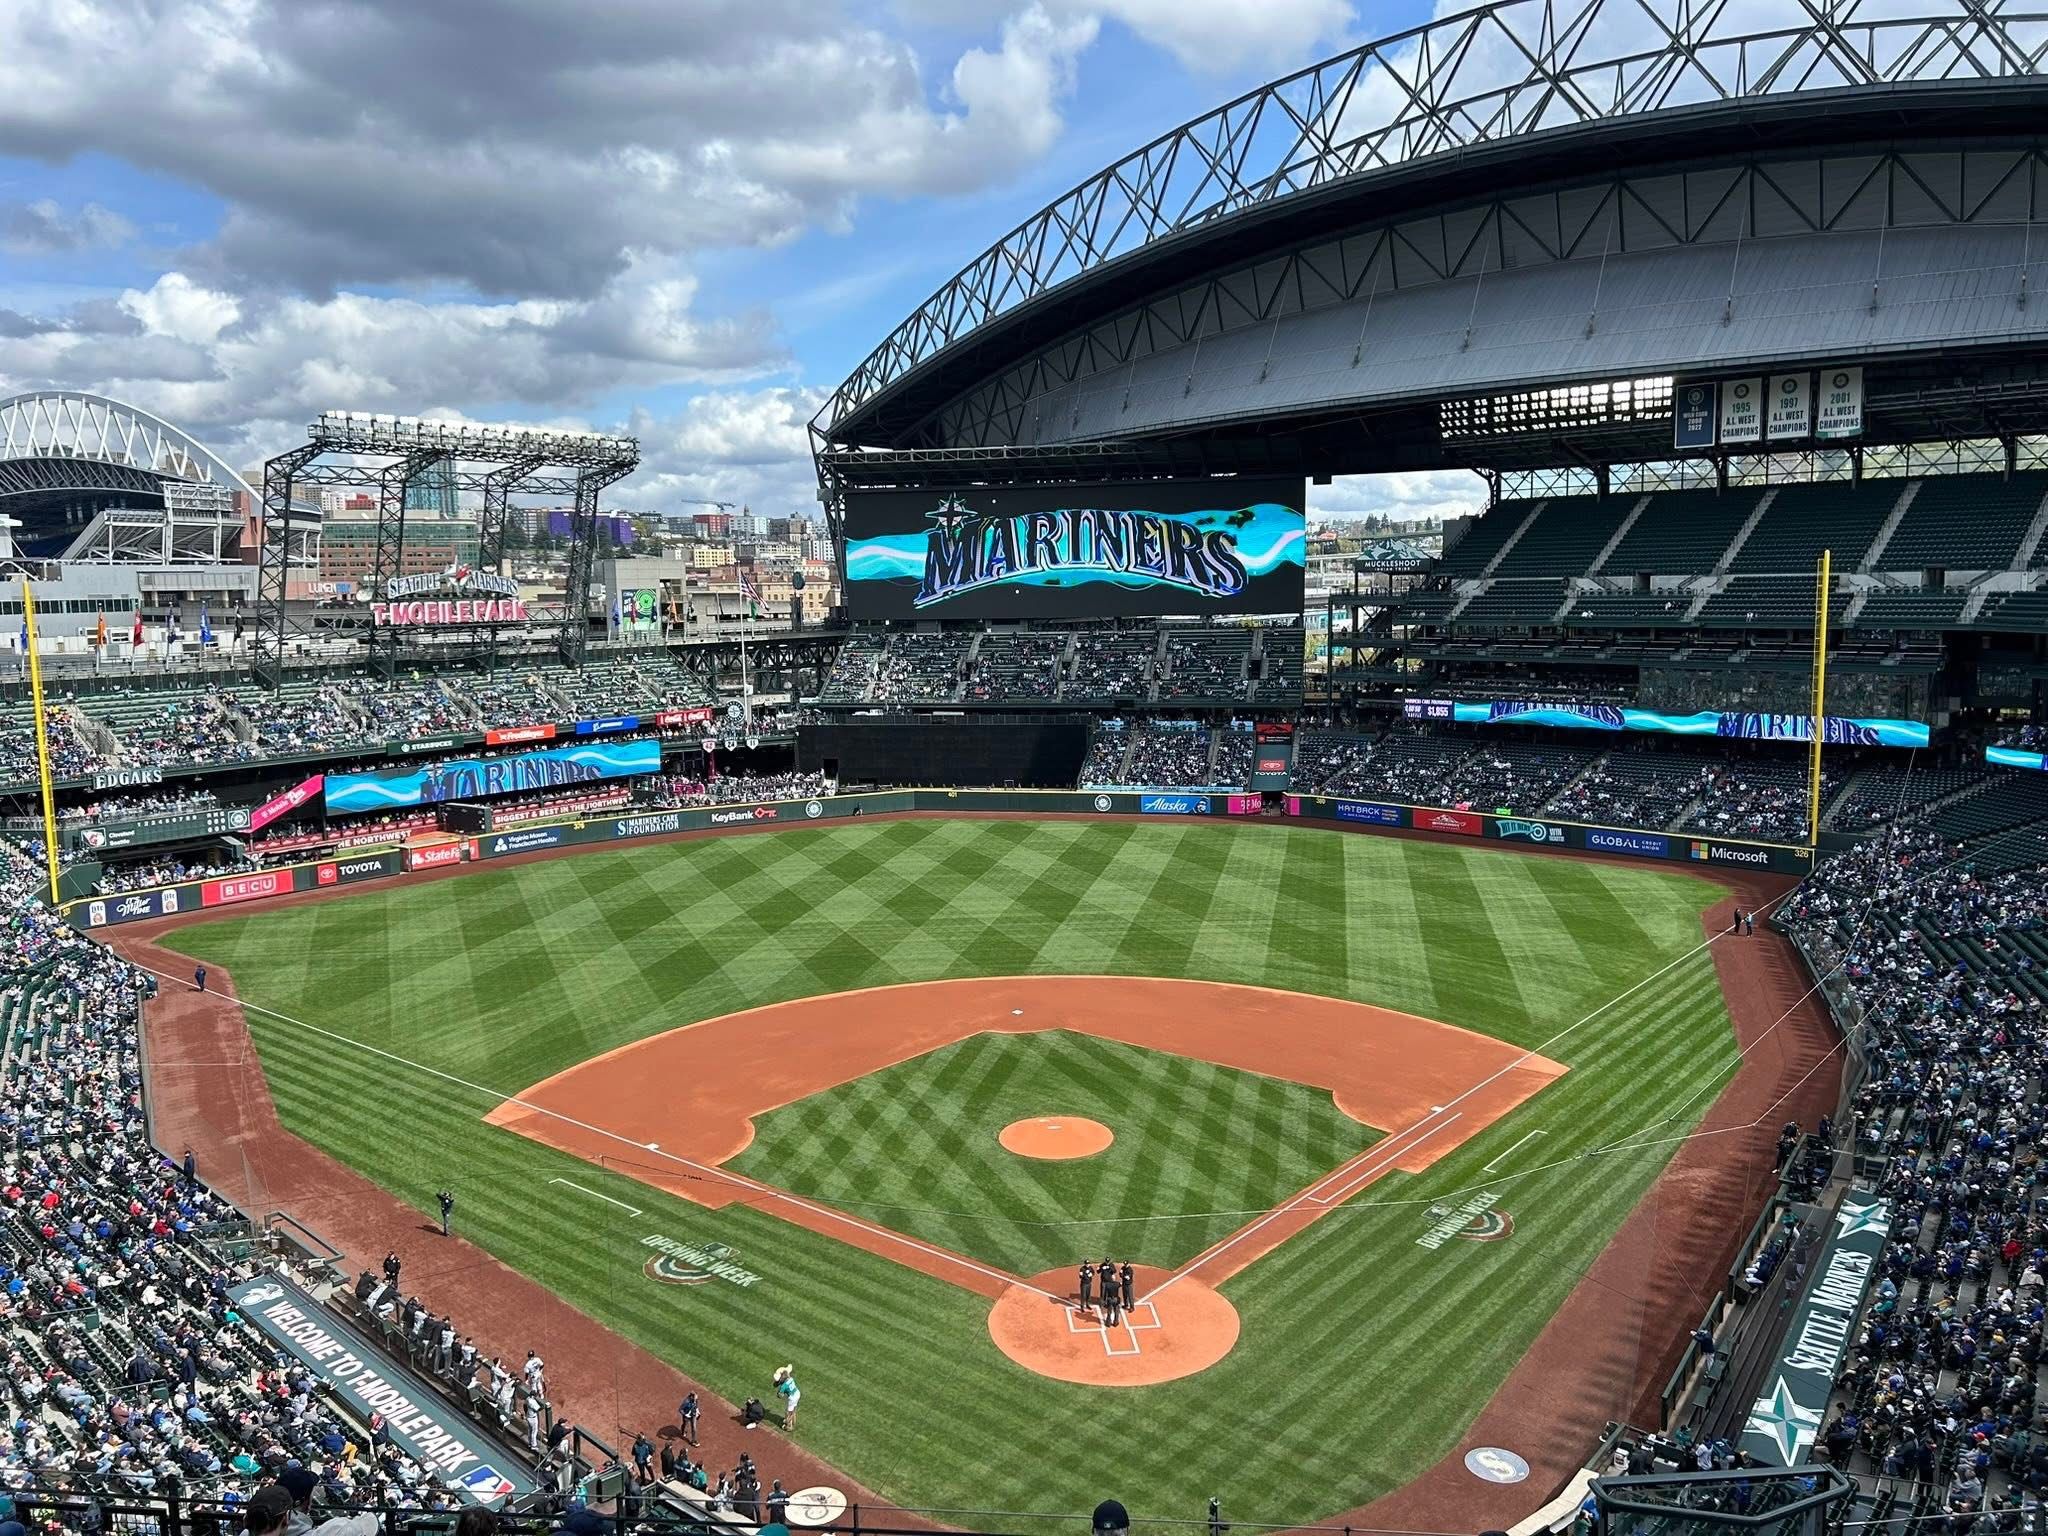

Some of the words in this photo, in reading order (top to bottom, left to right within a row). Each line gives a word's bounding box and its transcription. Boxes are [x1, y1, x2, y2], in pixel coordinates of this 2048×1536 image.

[1780, 397, 1798, 409] 1997
[1830, 392, 1850, 405] 2001
[1732, 402, 1750, 413] 1995
[1837, 405, 1856, 415] WEST
[1738, 414, 1756, 425] WEST
[1785, 410, 1804, 420] WEST
[1769, 422, 1807, 434] CHAMPIONS
[1819, 417, 1858, 430] CHAMPIONS
[1722, 426, 1759, 438] CHAMPIONS
[913, 507, 1248, 609] MARINERS
[1364, 560, 1421, 568] MUCKLESHOOT
[308, 583, 337, 593] LUMEN
[389, 573, 440, 597] SEATTLE
[466, 571, 518, 595] MARINERS
[371, 600, 471, 625] T-MOBILE
[473, 600, 529, 622] PARK
[411, 740, 453, 750] STARBUCKS
[95, 769, 162, 789] EDGARS
[1145, 798, 1187, 812] Alaska
[1338, 804, 1380, 815] HATBACK
[495, 812, 529, 823] BIGGEST
[540, 807, 558, 817] BEST
[570, 803, 584, 811] THE
[628, 816, 660, 826] MARINERS
[661, 813, 678, 822] CARE
[711, 810, 753, 823] KeyBank
[109, 830, 135, 838] Cleveland
[628, 821, 680, 835] FOUNDATION
[337, 839, 350, 848] HE
[353, 830, 412, 846] NORTHWEST
[508, 834, 528, 842] Virginia
[529, 832, 548, 840] Mason
[509, 839, 539, 849] Franciscan
[539, 836, 557, 845] Health
[1591, 834, 1639, 849] GLOBAL
[425, 849, 449, 863] State
[1711, 847, 1768, 864] Microsoft
[339, 861, 381, 876] TOYOTA
[224, 879, 273, 897] BECU
[1459, 1190, 1502, 1215] WEEK
[1415, 1211, 1476, 1250] OPENING
[640, 1233, 715, 1267] OPENING
[707, 1260, 763, 1288] WEEK
[1808, 1248, 1873, 1315] MARINERS
[1783, 1309, 1851, 1376] SEATTLE
[262, 1300, 346, 1361] WELCOME
[325, 1352, 364, 1377] TO
[345, 1369, 435, 1435] T-MOBILE
[409, 1424, 480, 1474] PARK
